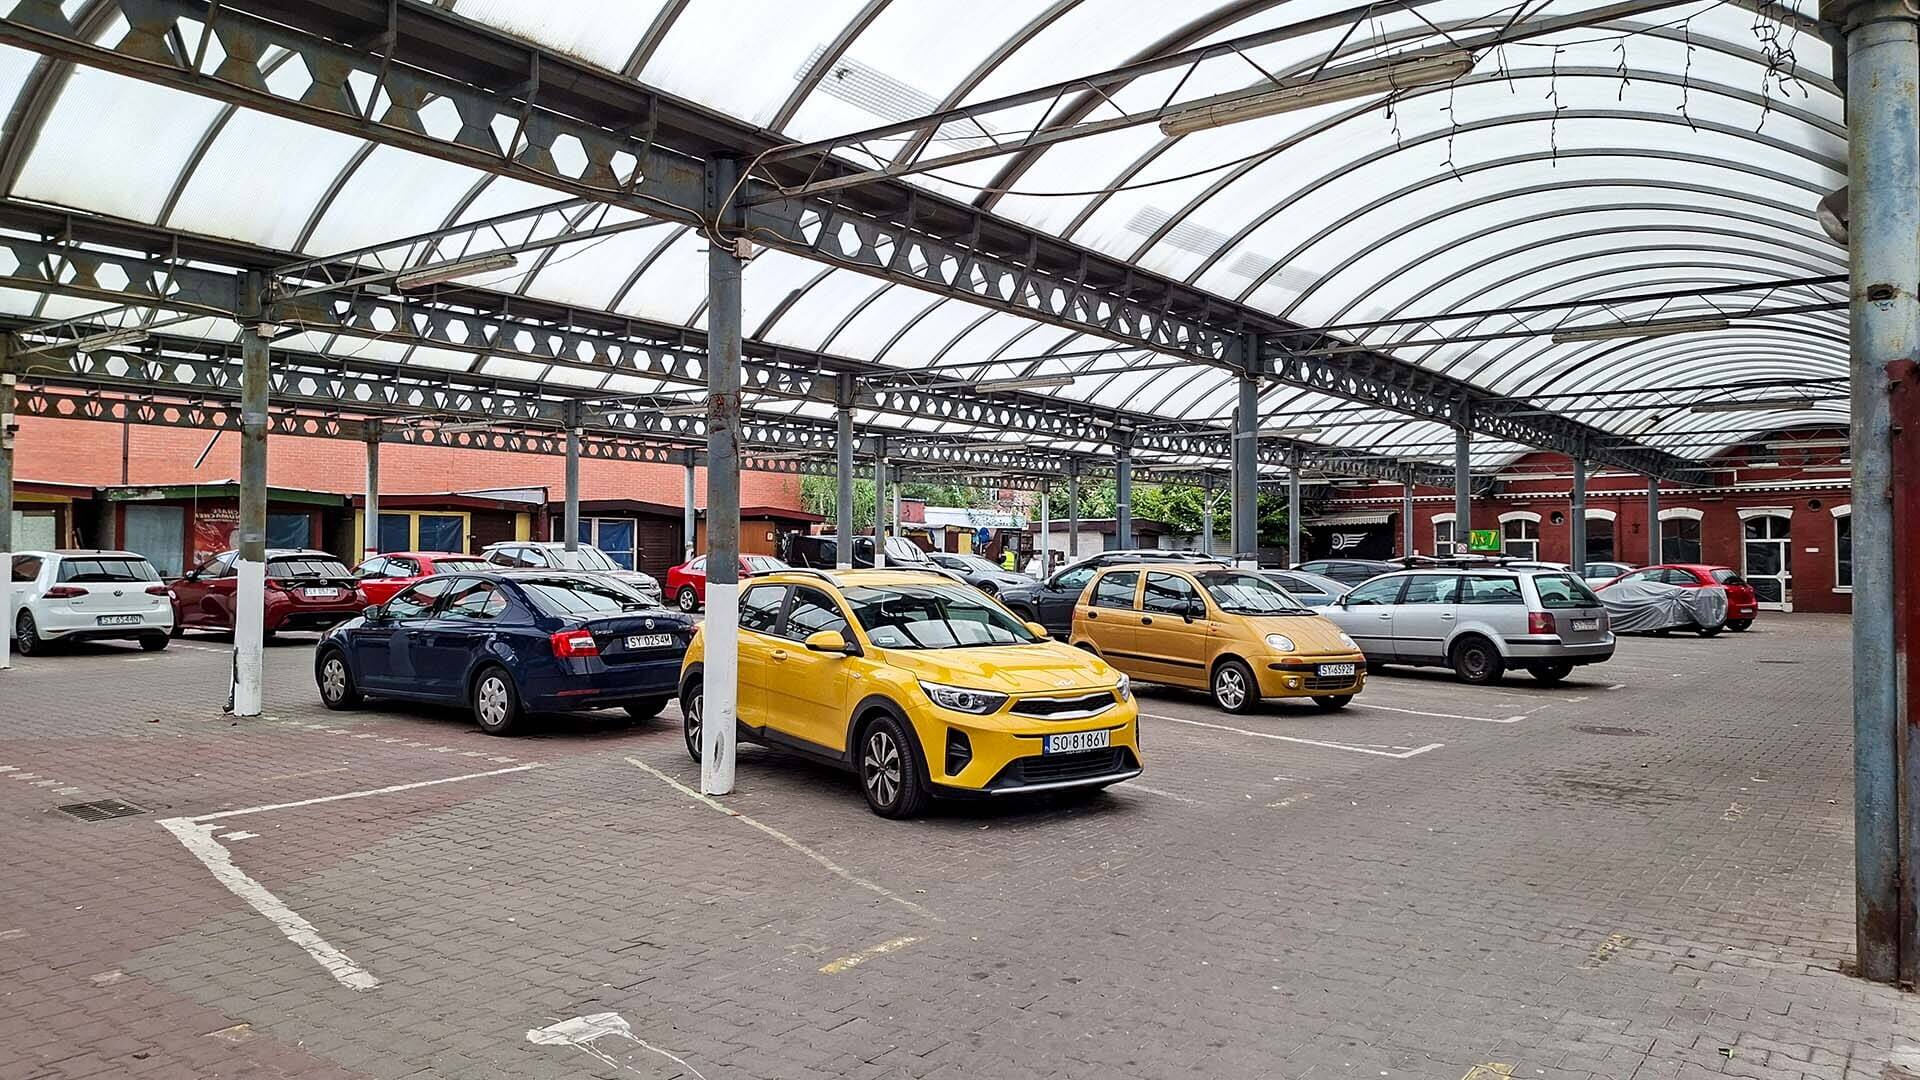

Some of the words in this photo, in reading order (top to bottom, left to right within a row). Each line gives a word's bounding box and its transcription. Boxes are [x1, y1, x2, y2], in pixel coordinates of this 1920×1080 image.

[1488, 531, 1497, 547] 7
[630, 636, 641, 647] SY
[644, 634, 671, 646] 0254M
[1322, 665, 1331, 675] SY
[1053, 736, 1068, 751] SO
[1072, 731, 1107, 749] 8186V
